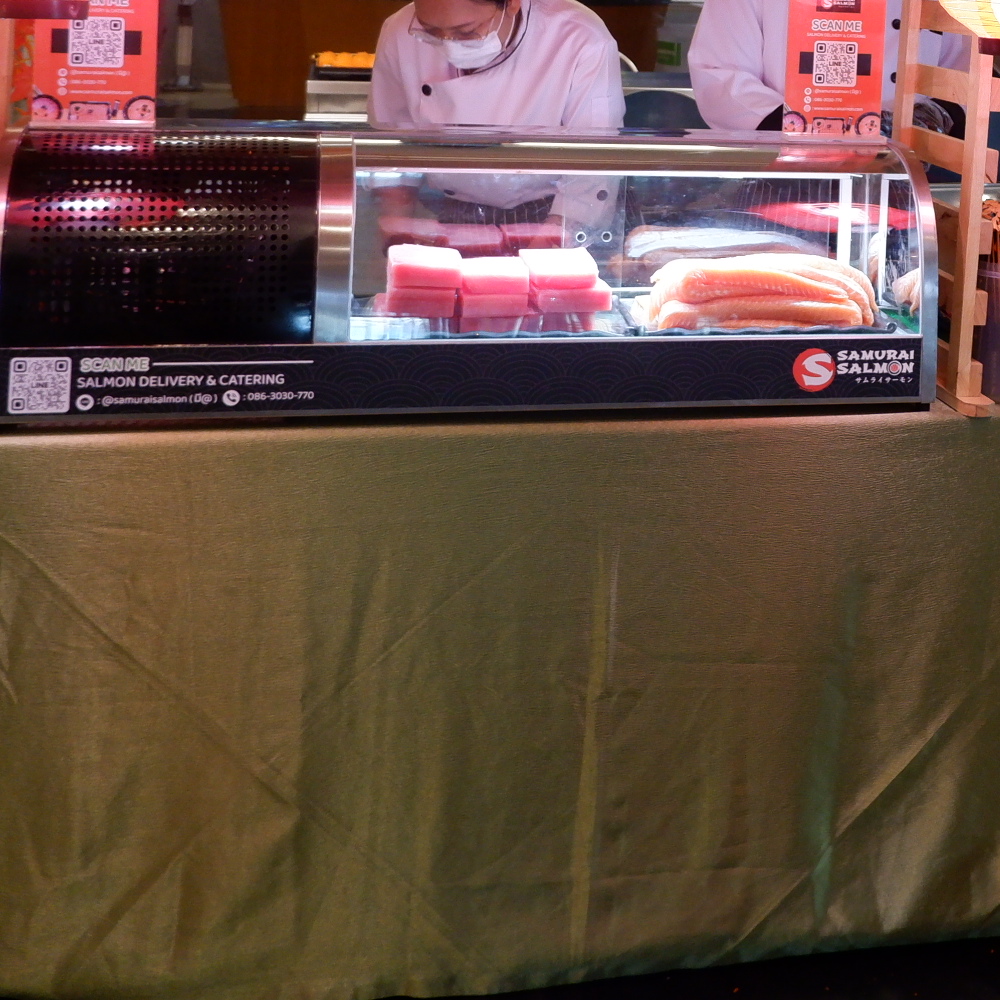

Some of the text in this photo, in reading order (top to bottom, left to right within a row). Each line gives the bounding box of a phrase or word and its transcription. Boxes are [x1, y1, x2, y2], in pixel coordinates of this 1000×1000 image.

[811, 18, 863, 33] SCAN ME
[837, 349, 915, 361] SAMURAI
[80, 356, 151, 373] SCAN ME
[837, 360, 915, 376] SALMON
[77, 373, 285, 389] SALMON DELIVERY & CATERING
[855, 376, 914, 384] サムライサーモン
